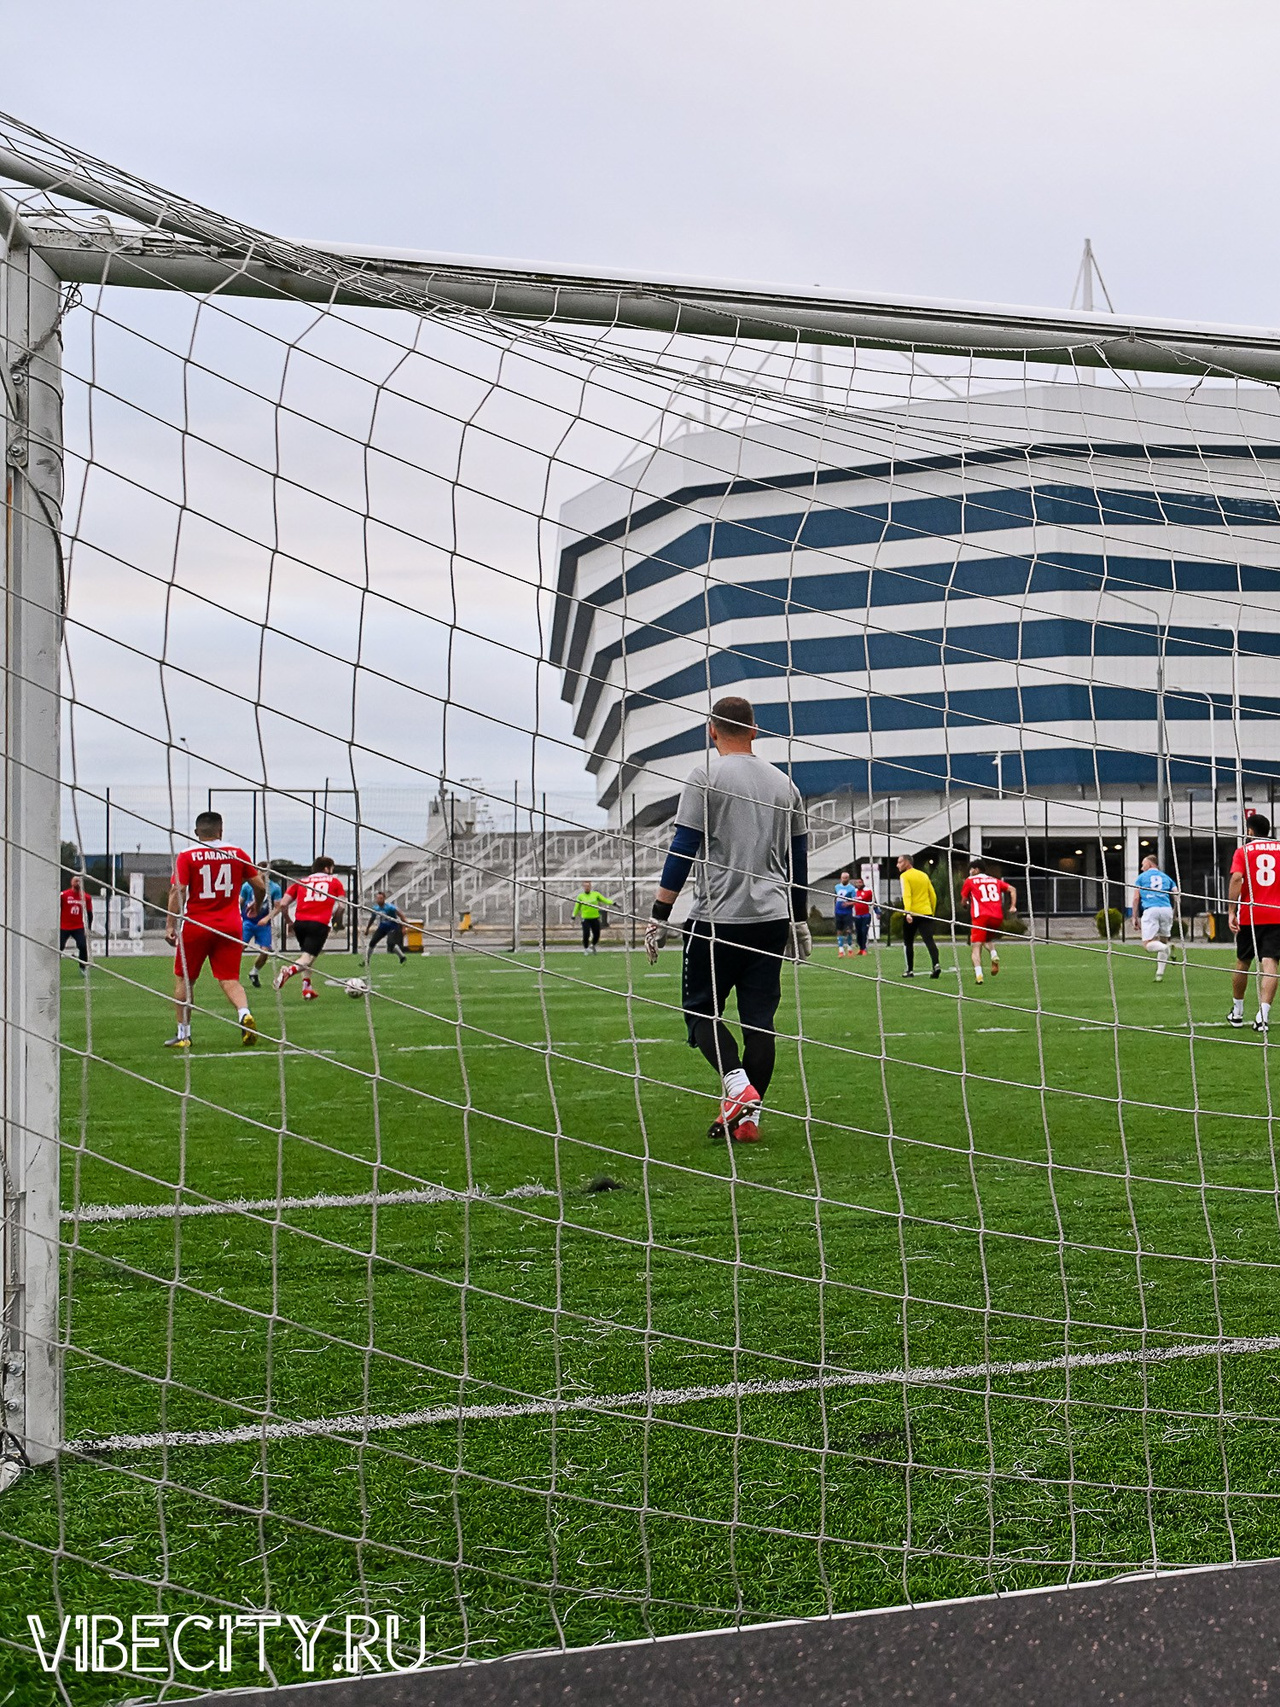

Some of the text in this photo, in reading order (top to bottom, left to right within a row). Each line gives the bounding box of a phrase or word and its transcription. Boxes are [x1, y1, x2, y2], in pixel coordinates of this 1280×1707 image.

[191, 851, 204, 861] FC
[199, 863, 234, 899] 14
[1256, 853, 1276, 886] 8
[979, 883, 1000, 902] 18
